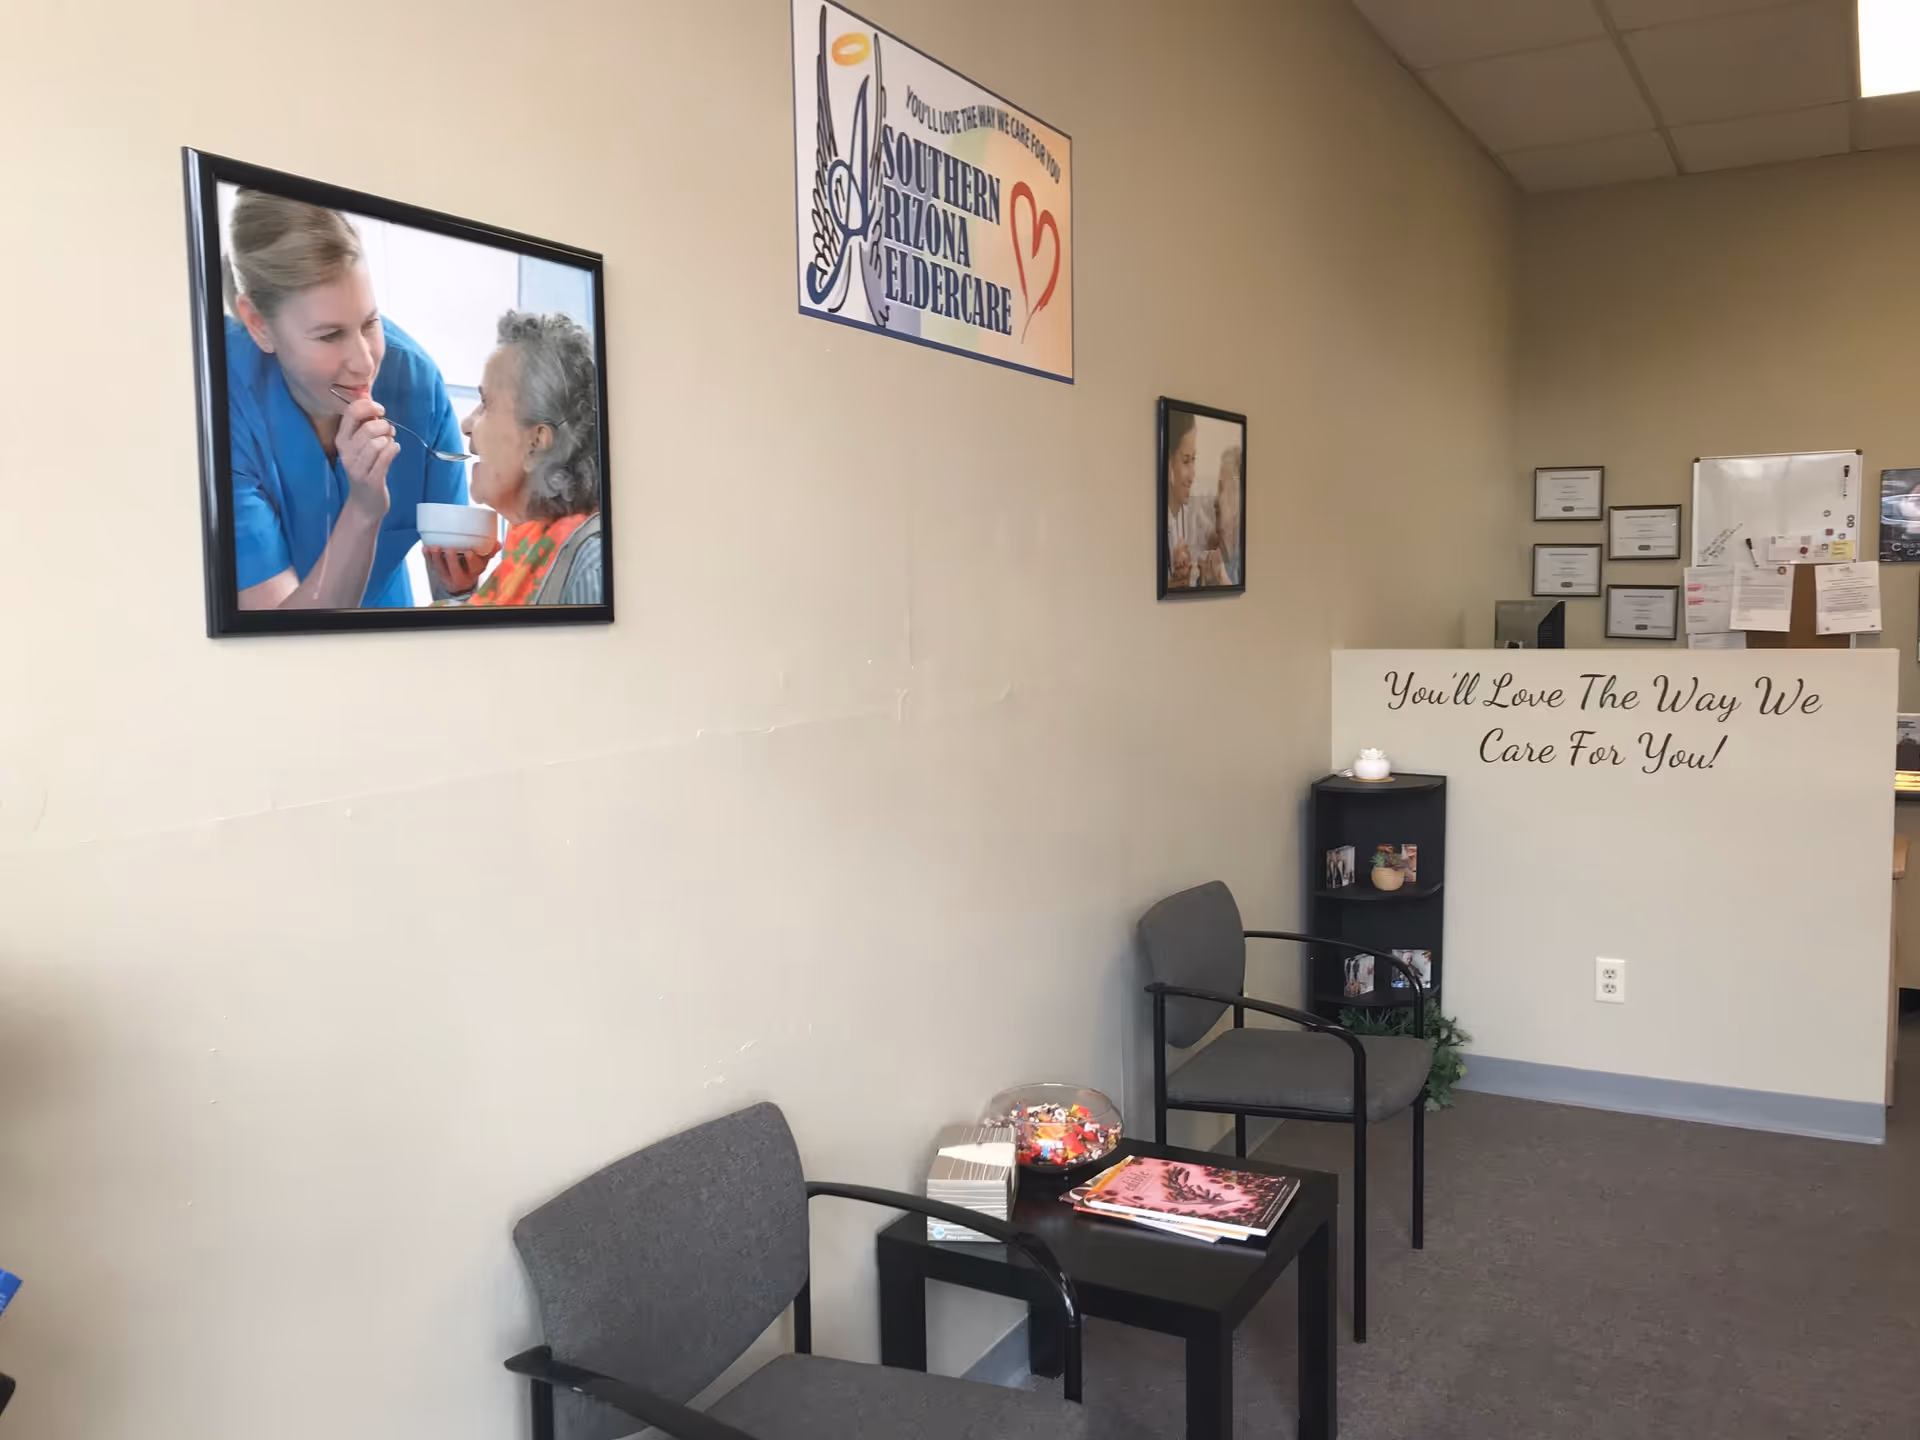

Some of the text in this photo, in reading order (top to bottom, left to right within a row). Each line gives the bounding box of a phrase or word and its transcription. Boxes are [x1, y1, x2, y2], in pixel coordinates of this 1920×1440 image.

[882, 123, 1001, 226] SOUTHERN
[905, 84, 1062, 185] YOU'LL LOVE THE WAY WE CARE FOR YOU
[883, 183, 972, 269] RIZONA
[884, 244, 1012, 336] ELDERCARE
[1384, 671, 1823, 723] You'll Love The Way We
[1479, 727, 1729, 774] Care For You!
